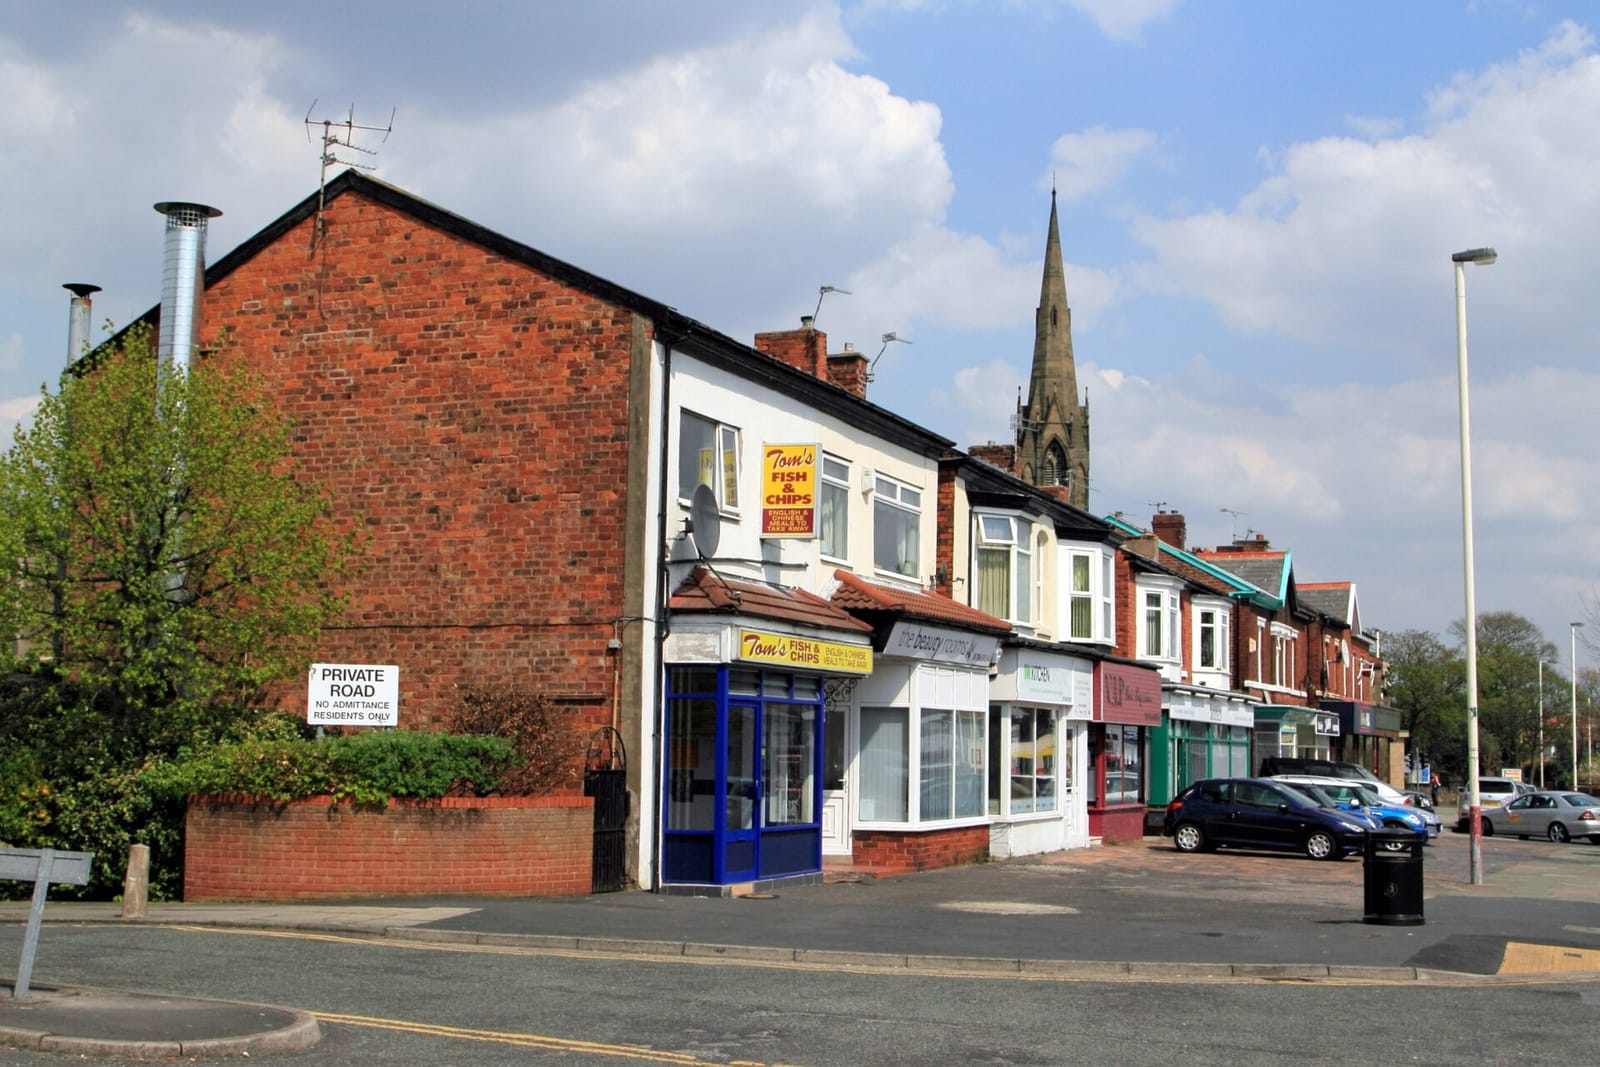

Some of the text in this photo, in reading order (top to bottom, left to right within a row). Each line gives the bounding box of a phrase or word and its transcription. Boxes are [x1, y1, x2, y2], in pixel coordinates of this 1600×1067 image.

[767, 448, 815, 469] Tom's
[772, 472, 807, 482] FISH
[782, 483, 795, 493] &
[766, 494, 812, 504] CHIPS
[744, 635, 787, 657] Tom's
[789, 640, 820, 653] FISH &
[898, 625, 968, 660] the beauty rooms
[790, 651, 820, 664] CHIPS
[825, 647, 843, 657] ENGLISH
[848, 650, 866, 660] CHINESE
[824, 656, 839, 665] MEALS
[839, 657, 845, 666] TO
[845, 658, 856, 668] TAKE
[322, 668, 384, 682] PRIVATE
[1031, 664, 1050, 682] KITCHEN
[330, 684, 375, 697] ROAD
[333, 701, 390, 709] ADMITTANCE
[314, 712, 391, 721] RESIDENTS ONLY
